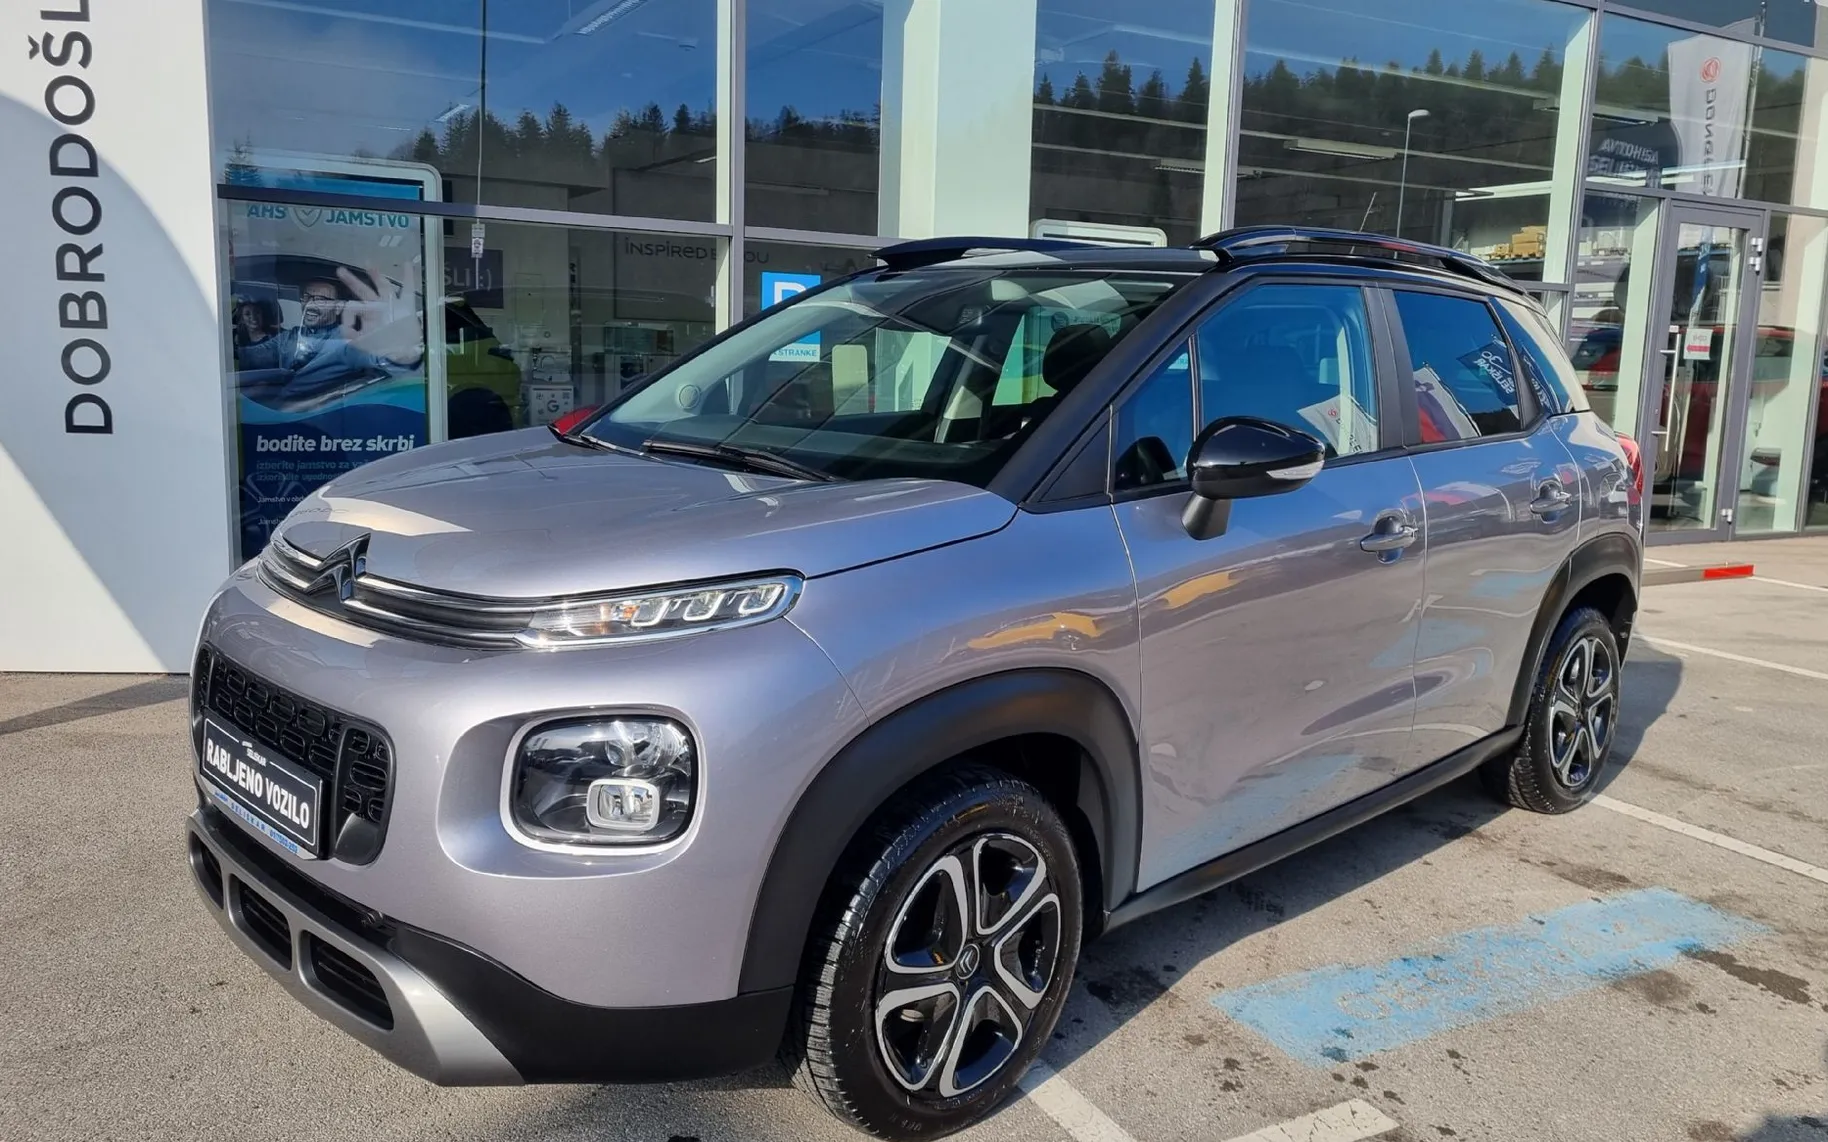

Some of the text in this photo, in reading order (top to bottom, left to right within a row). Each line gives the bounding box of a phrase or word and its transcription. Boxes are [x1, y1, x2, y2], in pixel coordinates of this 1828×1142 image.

[325, 209, 409, 228] JAMSTVO
[779, 349, 817, 357] STRANKE
[256, 434, 414, 452] bodite brez skrbi
[297, 460, 337, 473] jamstvo
[206, 738, 310, 829] RABLJENO VOZILO
